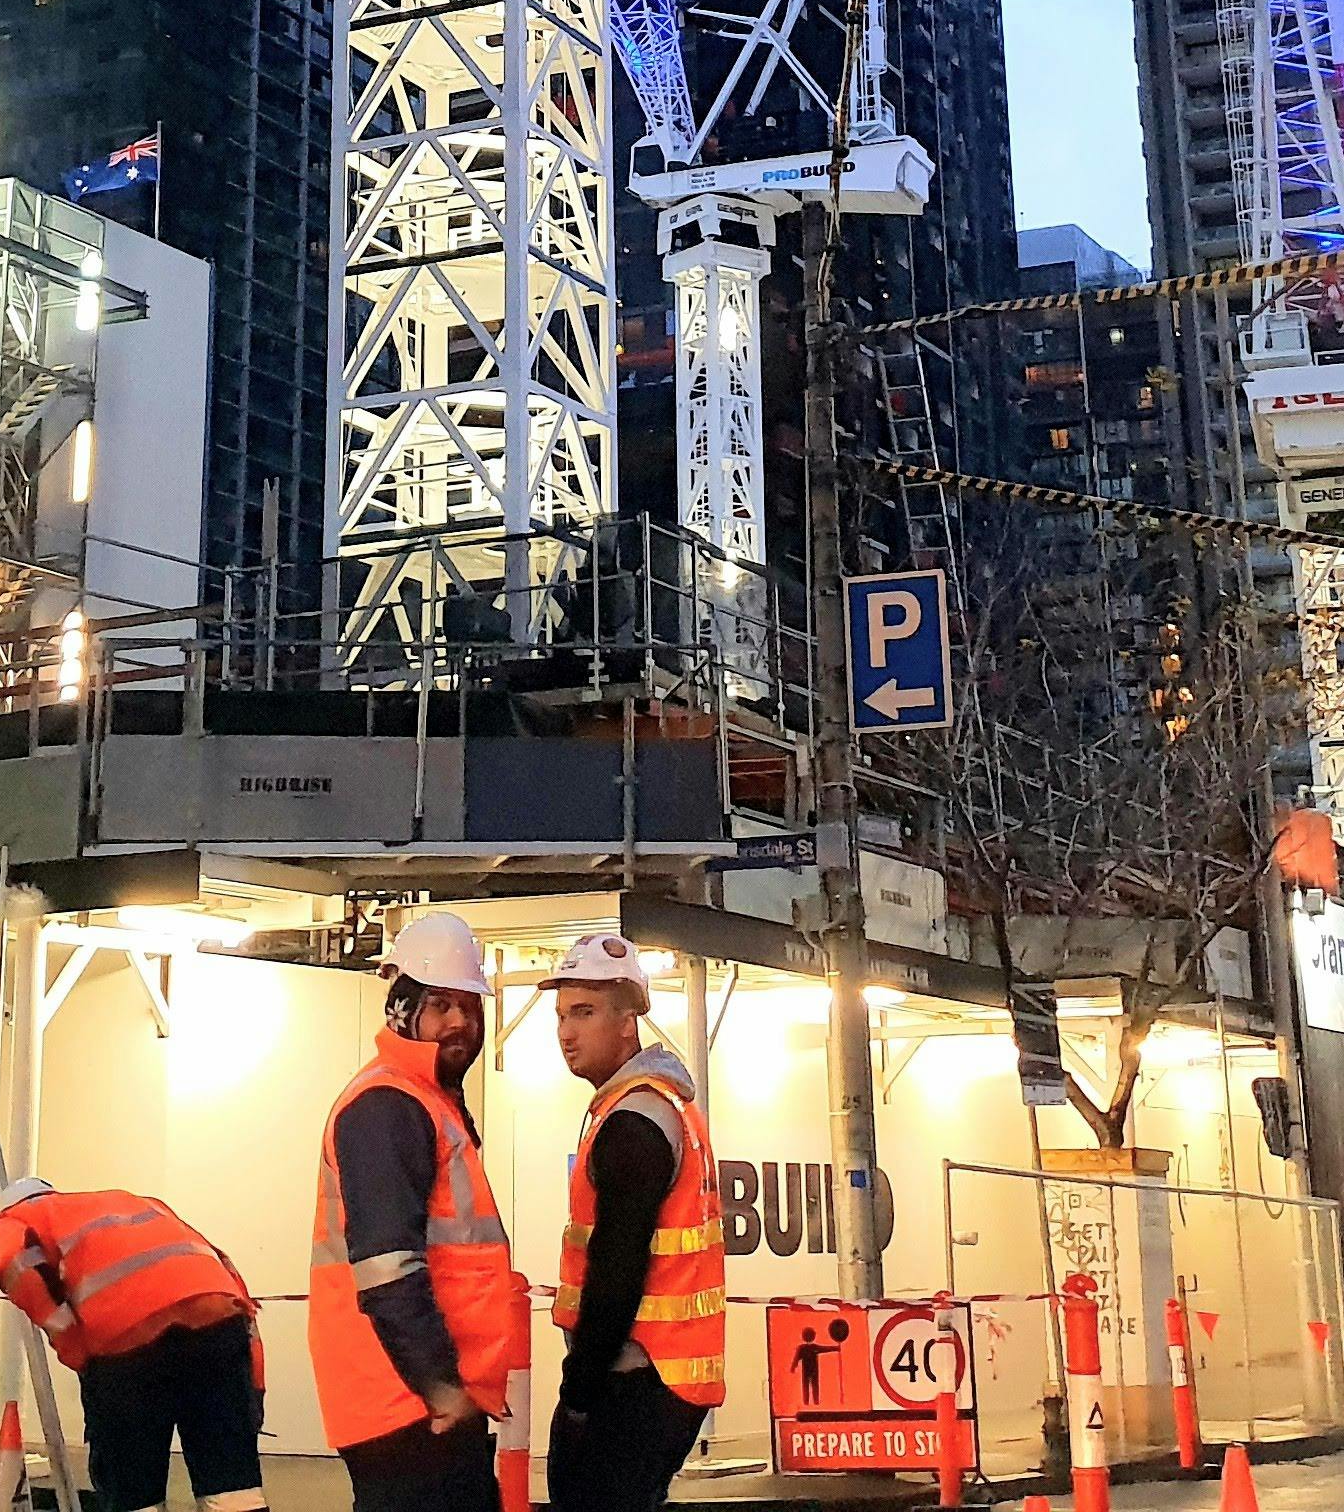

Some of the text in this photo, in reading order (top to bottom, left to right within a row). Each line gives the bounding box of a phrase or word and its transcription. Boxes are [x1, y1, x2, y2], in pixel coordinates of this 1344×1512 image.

[762, 161, 856, 183] PROBUD
[866, 590, 922, 668] P
[791, 1430, 942, 1458] PREPARE TO ST
